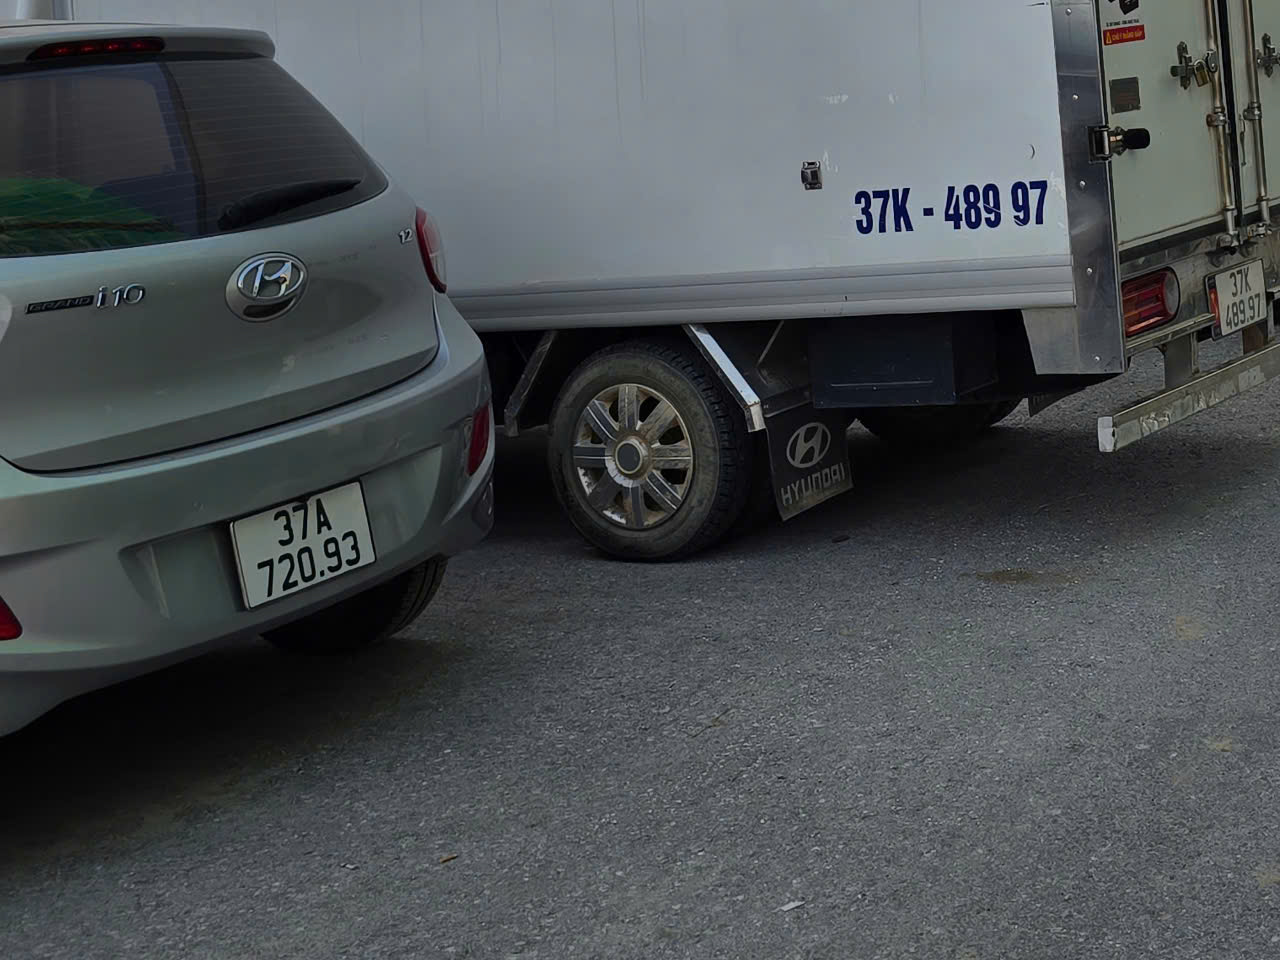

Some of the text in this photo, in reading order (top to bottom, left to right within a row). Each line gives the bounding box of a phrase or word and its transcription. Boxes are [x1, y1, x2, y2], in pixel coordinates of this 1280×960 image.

[854, 188, 914, 235] 37K
[944, 183, 1002, 230] 489
[1010, 180, 1048, 227] 97
[29, 296, 91, 312] GRAND
[1229, 265, 1252, 298] 37K
[1225, 292, 1261, 330] 489.97
[780, 462, 846, 507] HYUNDAI
[273, 498, 332, 547] 37A
[256, 530, 361, 598] 720.93
